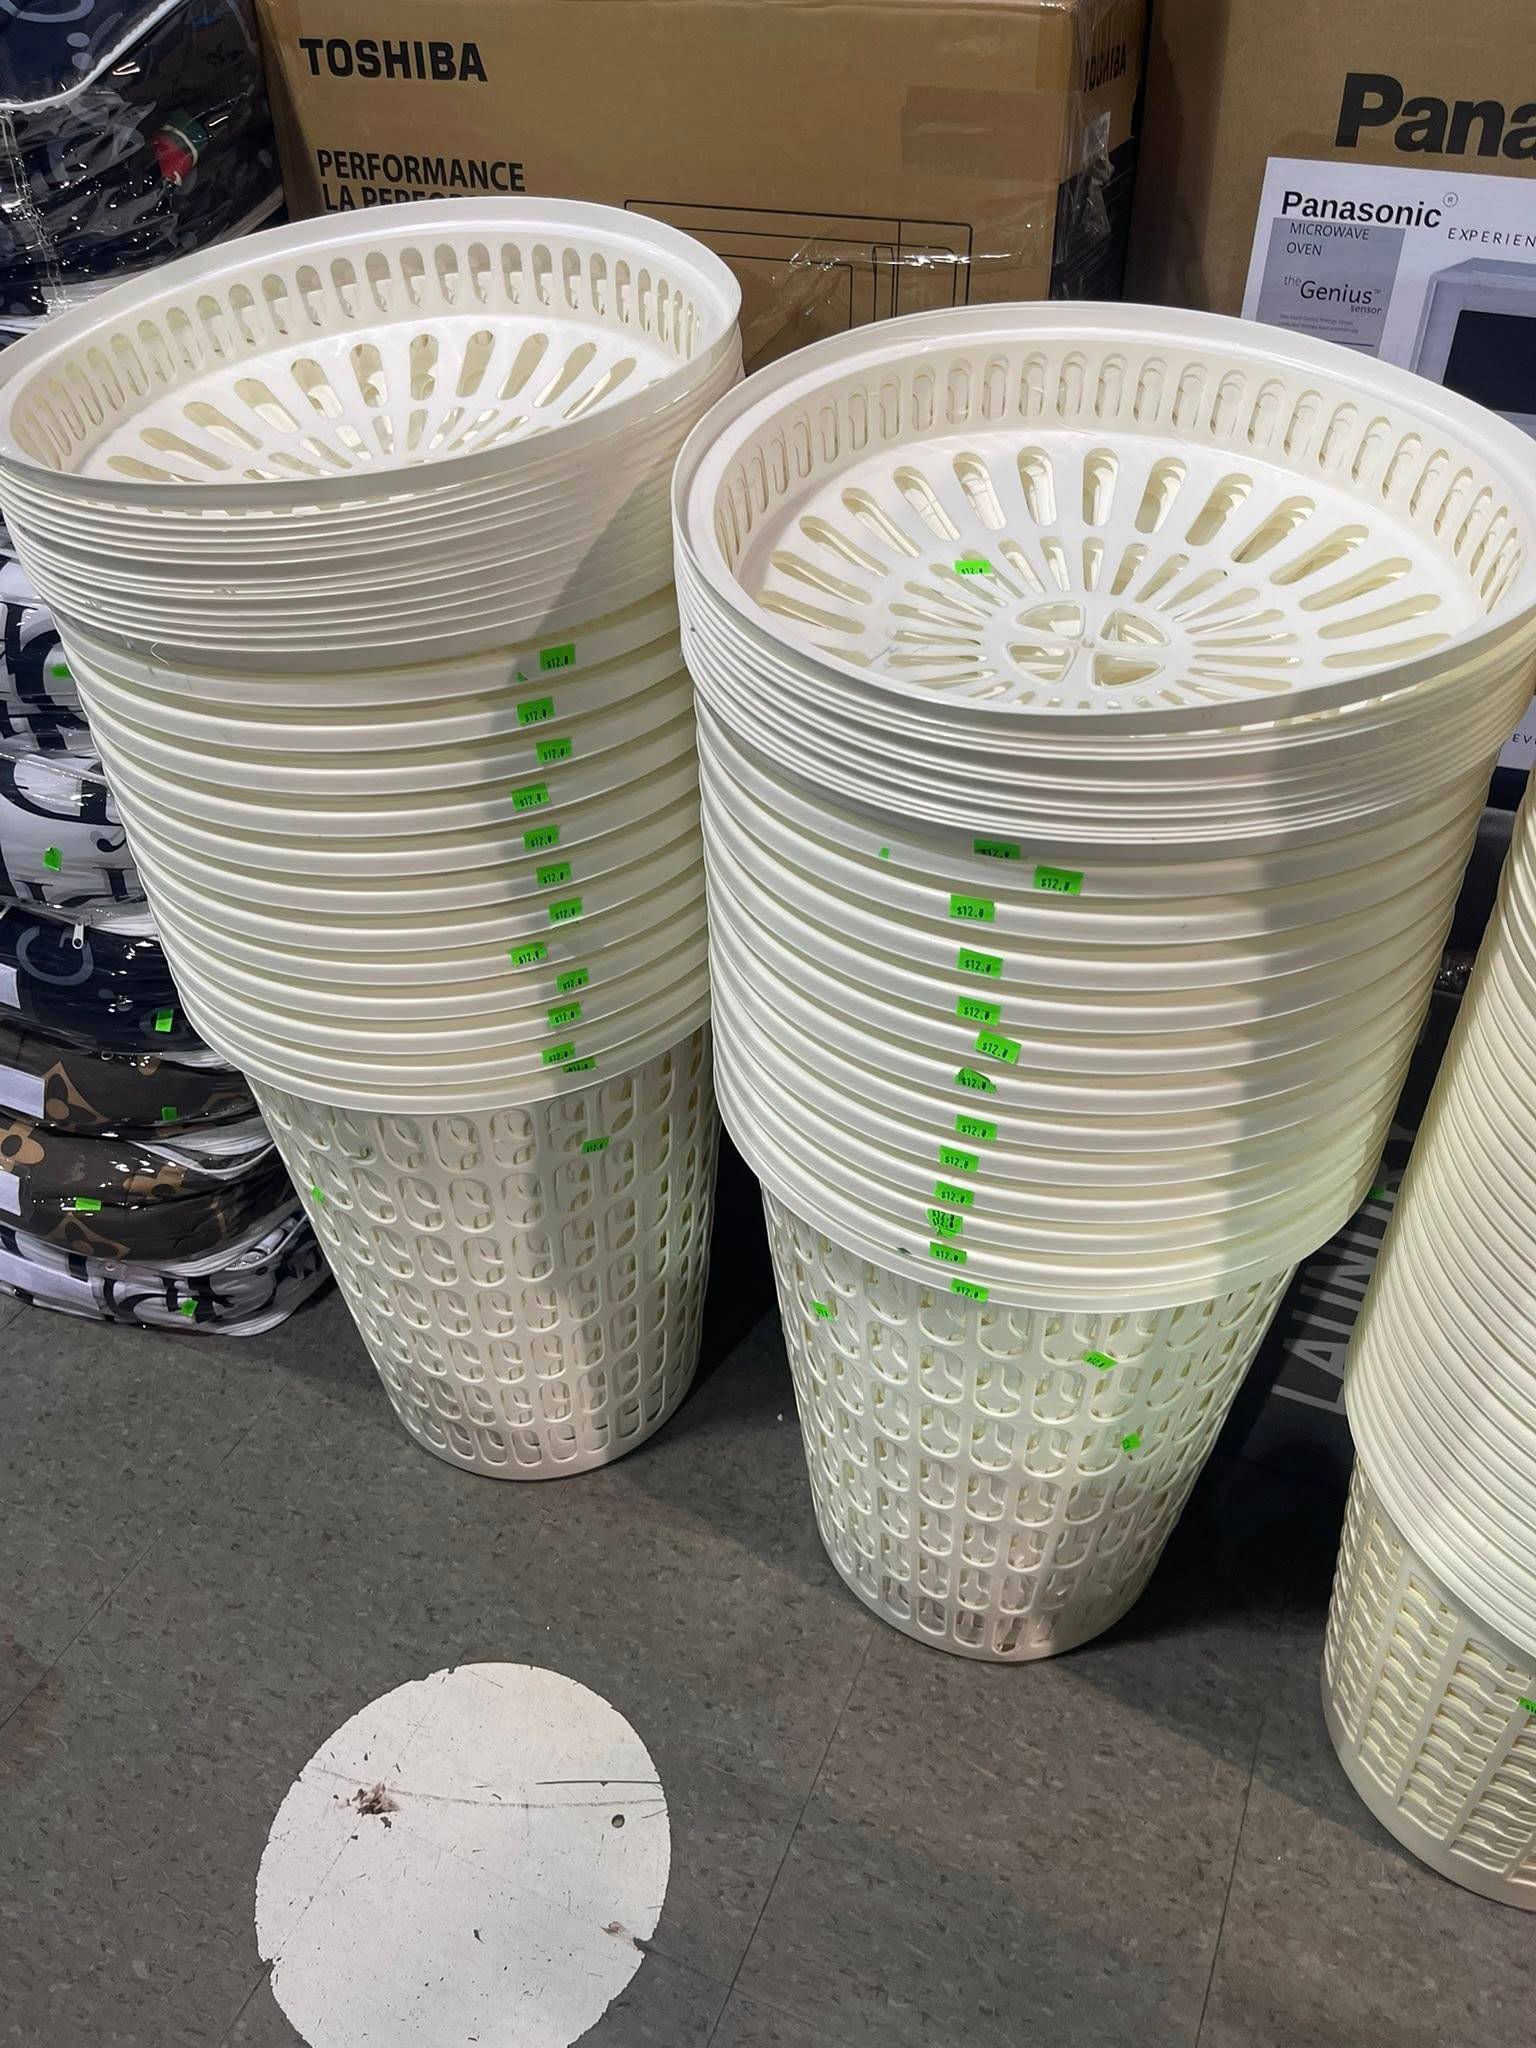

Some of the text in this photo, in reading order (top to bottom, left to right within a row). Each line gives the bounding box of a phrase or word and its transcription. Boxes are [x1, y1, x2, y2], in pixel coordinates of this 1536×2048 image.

[299, 38, 488, 82] TOSHIBA
[1083, 41, 1127, 93] TOSHIBA
[1334, 72, 1536, 159] Pana
[317, 150, 526, 192] PERFORMANCE
[322, 183, 356, 212] LA
[1281, 190, 1442, 228] Panasonic
[1289, 222, 1370, 240] MICROWAVE
[1286, 242, 1322, 256] OVEN
[1284, 275, 1373, 304] the Genius
[1350, 304, 1382, 315] sensor
[1512, 733, 1536, 744] EV
